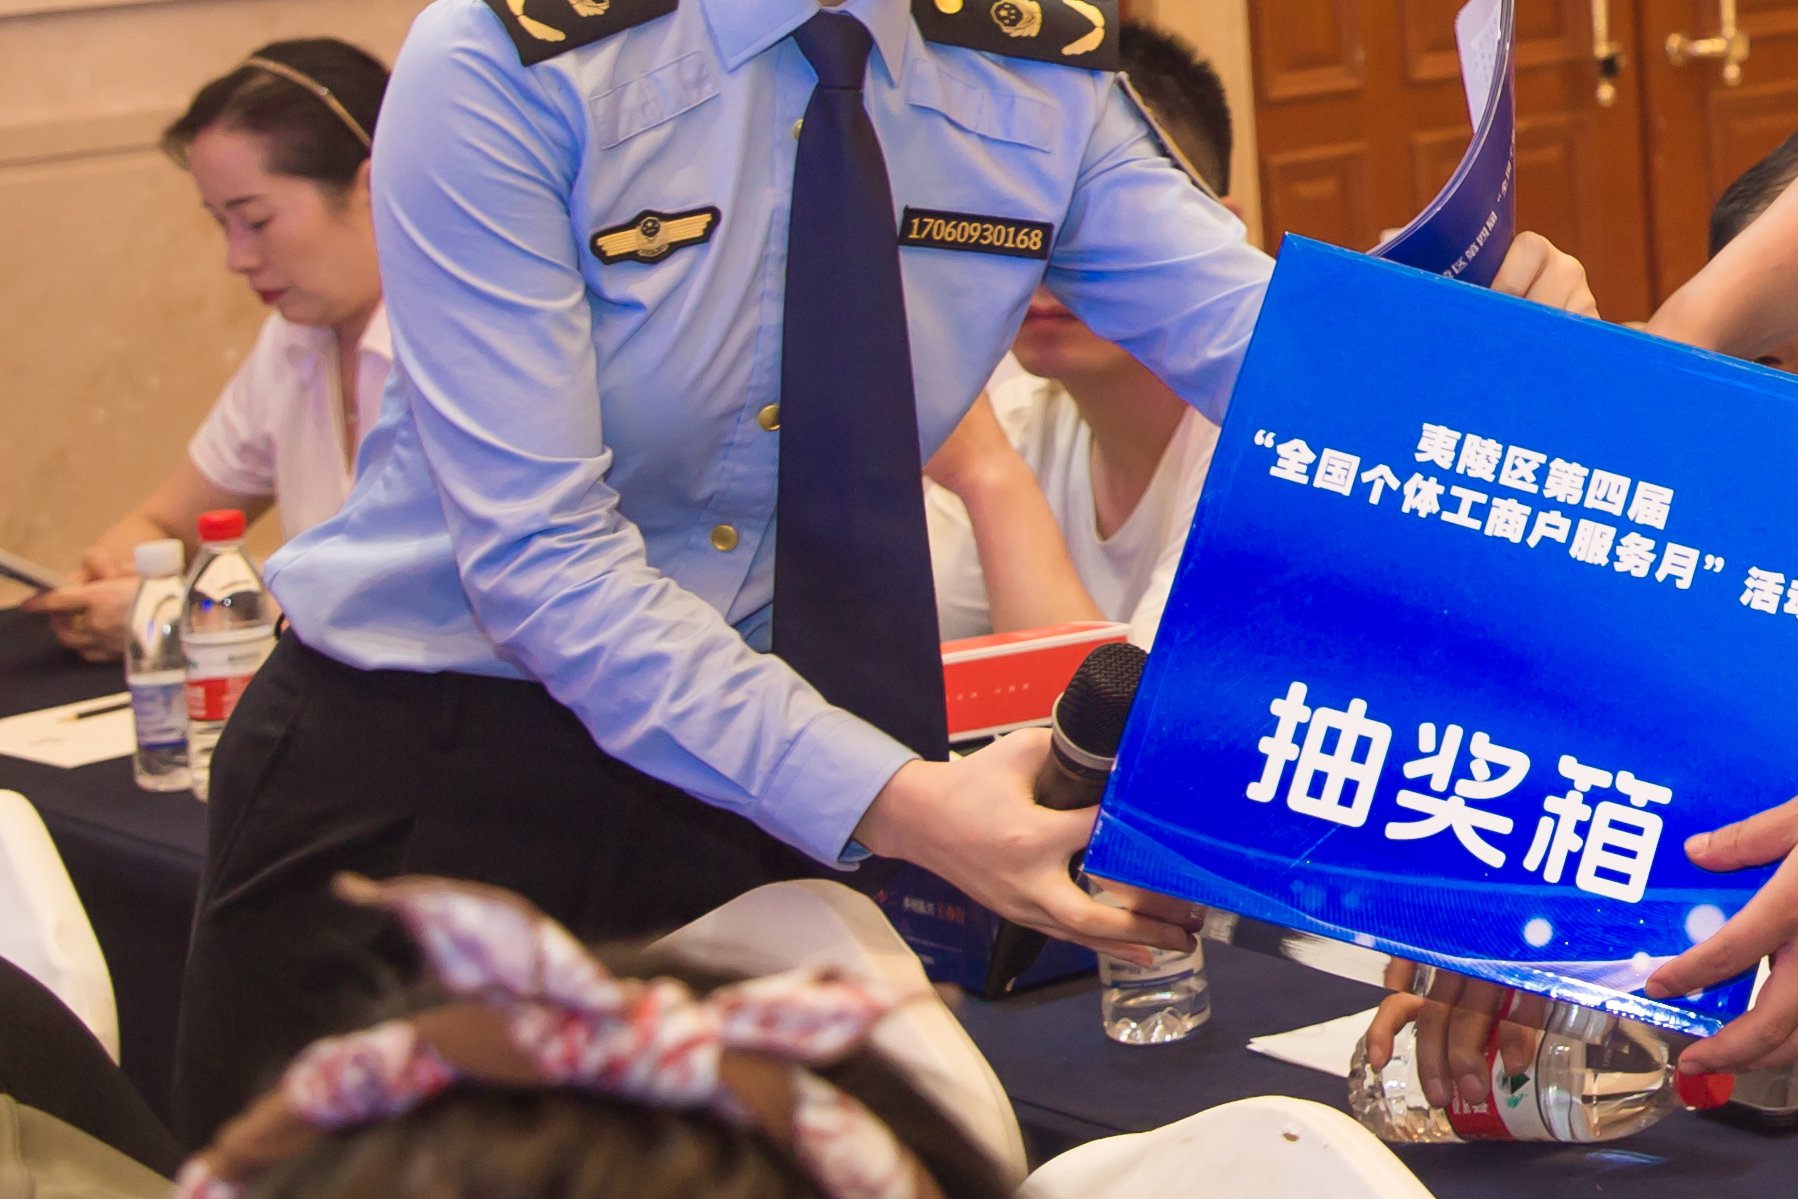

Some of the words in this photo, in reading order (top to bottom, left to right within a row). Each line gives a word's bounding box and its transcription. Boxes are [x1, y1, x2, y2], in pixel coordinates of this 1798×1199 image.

[908, 217, 1043, 250] 17060930168
[1414, 422, 1674, 530] 夷陵区第四届
[1246, 682, 1673, 904] 抽奖箱
